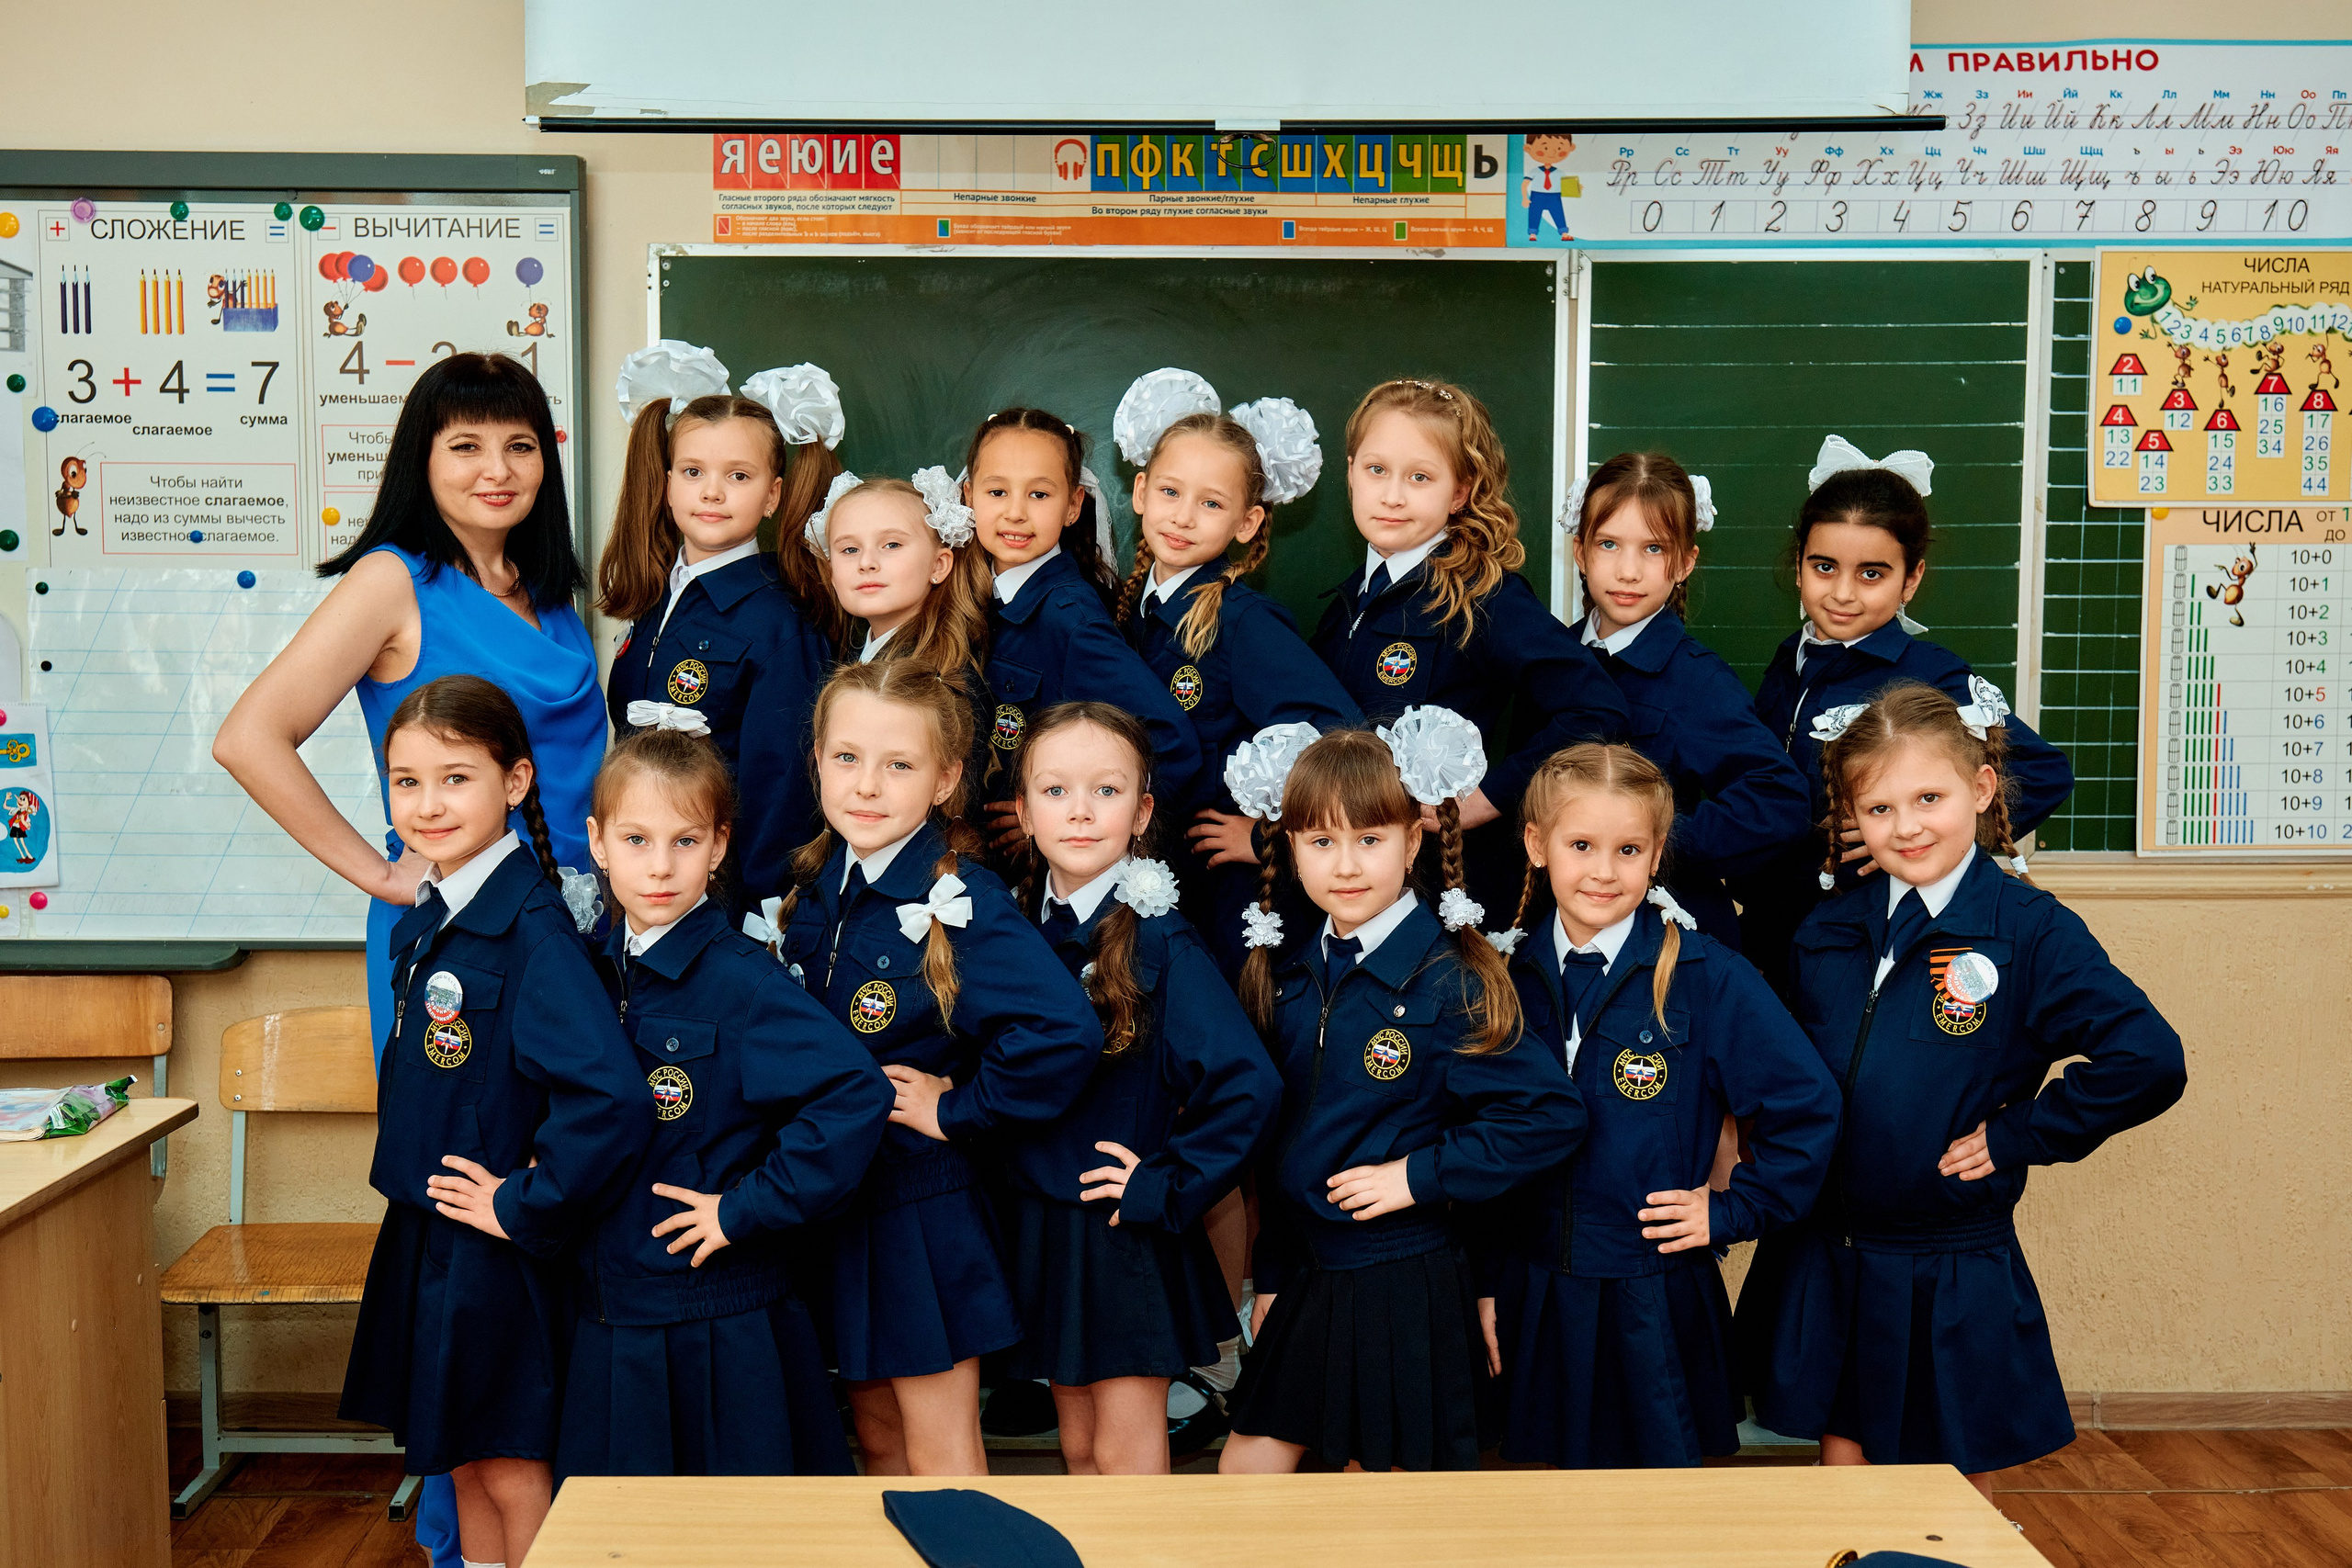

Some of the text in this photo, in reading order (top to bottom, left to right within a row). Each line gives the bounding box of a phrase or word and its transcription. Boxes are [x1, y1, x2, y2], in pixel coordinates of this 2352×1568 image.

[1949, 50, 2159, 72] ПРАВИЛЬНО
[1923, 89, 2346, 99] Жж Зз Ии Йй Кк Лл Мм Нн Оо Пп
[718, 194, 895, 204] Гласные второго ряда обозначают мягкость
[954, 193, 1036, 203] Непарные звонкие
[1149, 195, 1254, 203] Парные звонкие/глухие
[1353, 196, 1430, 205] Непарные глухие
[764, 203, 795, 211] звуков,
[821, 203, 855, 211] которых
[857, 203, 892, 211] следуют
[1106, 207, 1137, 215] втором
[1140, 208, 1160, 216] ряду
[1243, 208, 1268, 216] звуки
[1643, 200, 2308, 231] 0 1 2 3 4 5 6 7 8 9 10
[90, 219, 245, 240] СЛОЖЕНИЕ
[354, 218, 521, 238] ВЫЧИТАНИЕ
[2245, 257, 2310, 273] ЧИСЛА
[2201, 279, 2349, 296] НАТУРАЛЬНЫЙ РЯД
[2160, 311, 2348, 344] 1 2 3 4 5 6 7 8 9 10 11 12
[339, 341, 370, 385] 4
[67, 359, 96, 403] 3
[159, 360, 190, 403] 4
[251, 361, 279, 404] 7
[320, 394, 407, 406] уменьшаем
[240, 415, 288, 427] сумма
[132, 425, 213, 435] слагаемое
[150, 476, 243, 489] Чтобы найти
[109, 496, 289, 508] неизвестное слагаемое,
[114, 514, 286, 527] надо из суммы вычесть
[2202, 510, 2303, 532] ЧИСЛА
[2291, 549, 2332, 564] 10+0
[2290, 577, 2328, 592] 10+1
[2288, 604, 2329, 620] 10+2
[2287, 631, 2328, 646] 10+3
[2285, 659, 2326, 674] 10+4
[2284, 687, 2325, 702] 10+5
[2283, 714, 2324, 729] 10+6
[2282, 742, 2324, 757] 10+7
[2281, 769, 2323, 784] 10+8
[2280, 795, 2322, 811] 10+9
[2274, 825, 2327, 839] 10+10
[1936, 1014, 1980, 1033] EMERCOM
[427, 1043, 466, 1066] EMERCOM
[1618, 1077, 1662, 1098] EMERCOM
